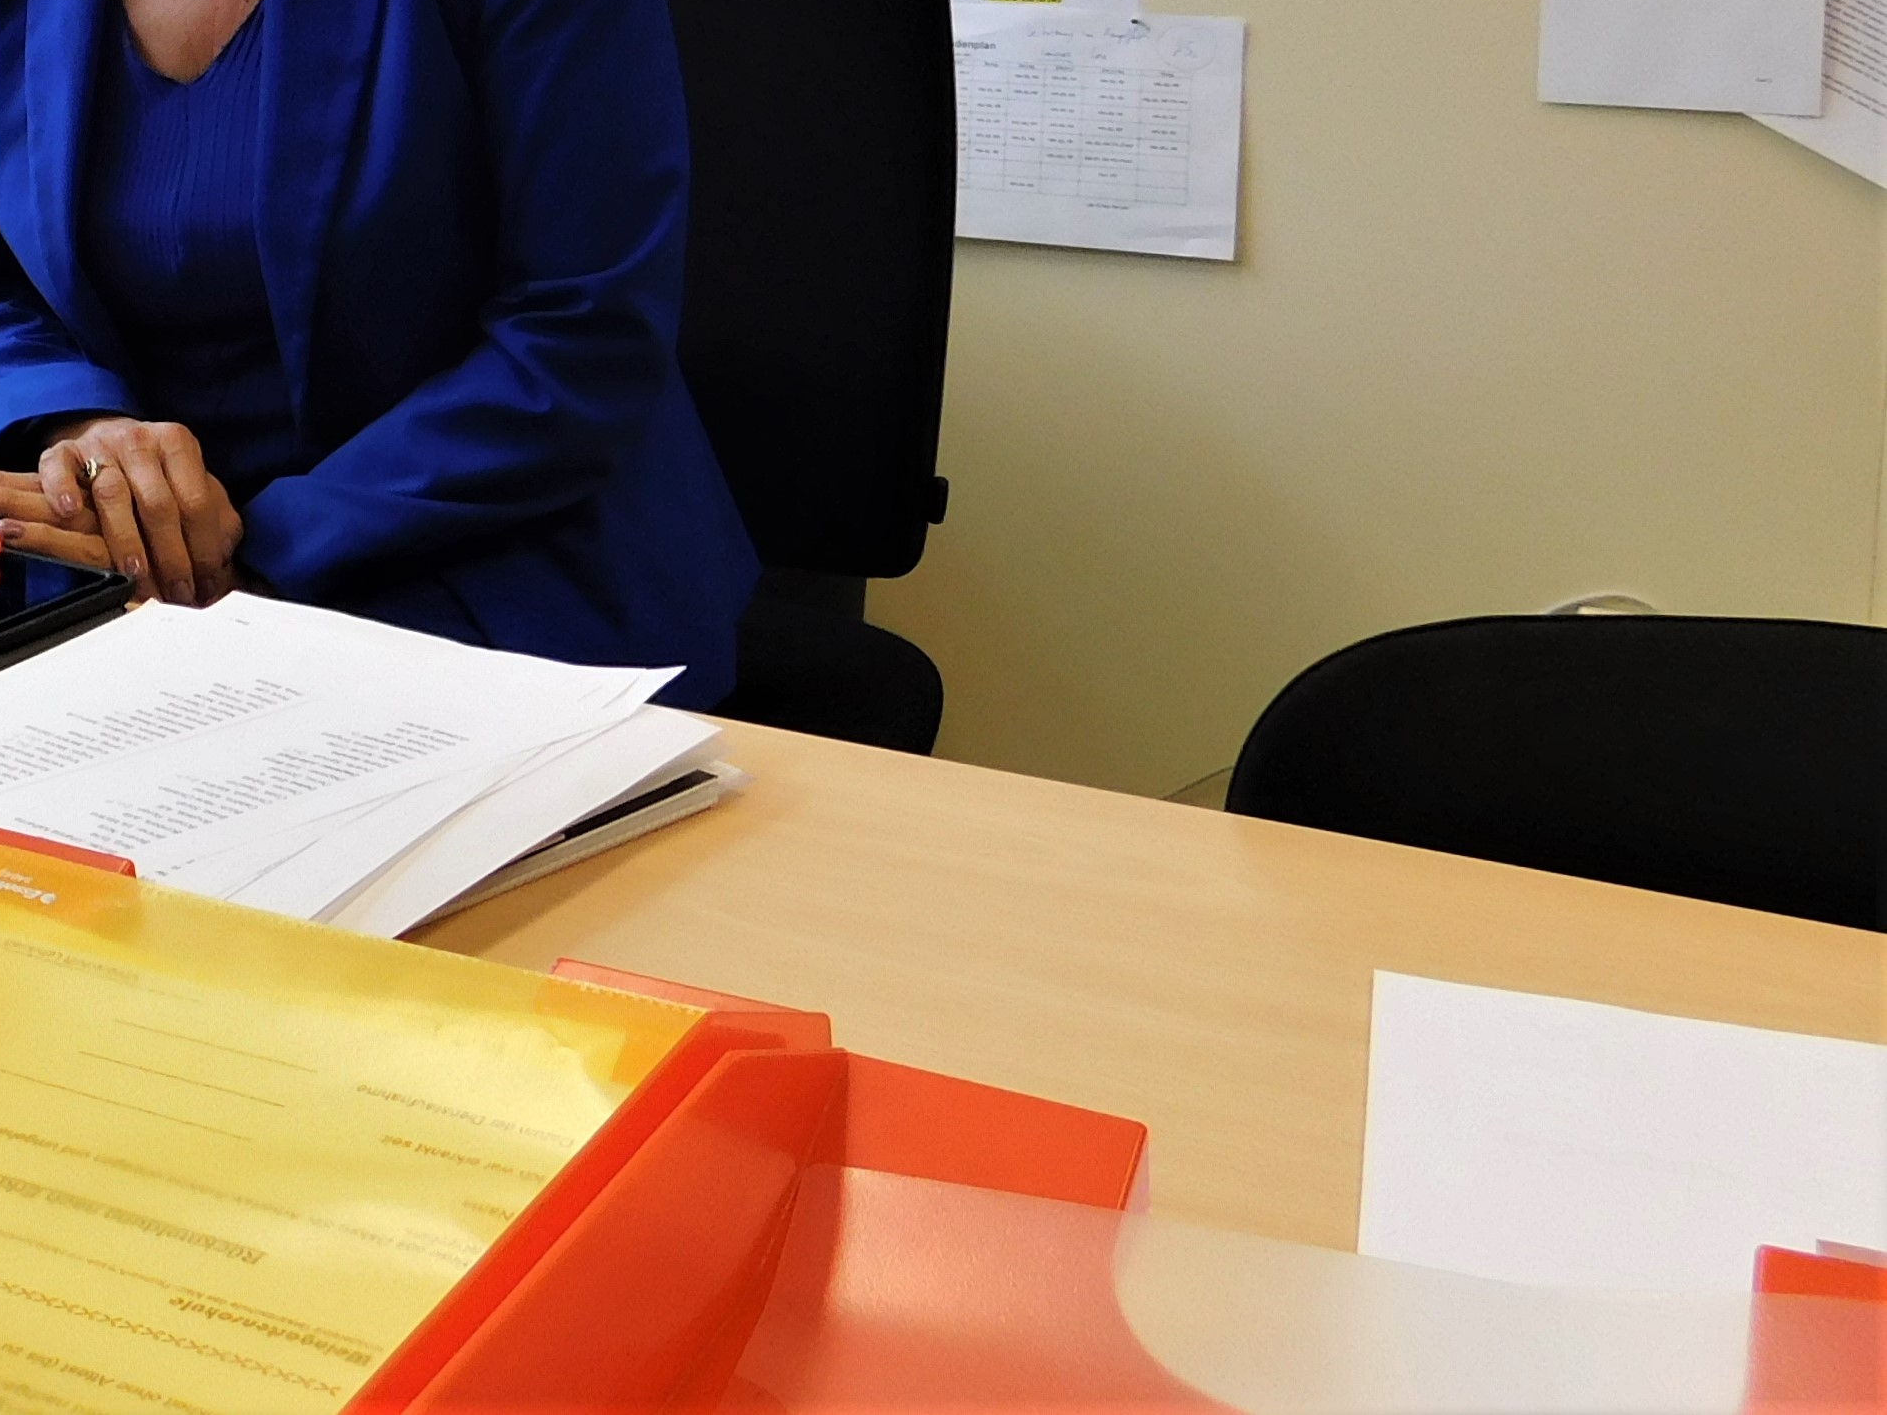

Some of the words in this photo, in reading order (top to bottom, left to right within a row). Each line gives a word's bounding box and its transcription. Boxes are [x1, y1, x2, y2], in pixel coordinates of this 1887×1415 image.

[354, 1082, 487, 1128] Dienstaufnahme
[485, 1117, 518, 1135] der
[414, 1141, 482, 1169] erkrankt
[482, 1159, 516, 1176] war
[43, 1187, 100, 1219] nach
[103, 1207, 266, 1267] Rückmeldung
[0, 1342, 24, 1358] zu
[23, 1349, 60, 1371] (bis
[60, 1358, 113, 1388] Attest
[114, 1381, 162, 1403] ohne
